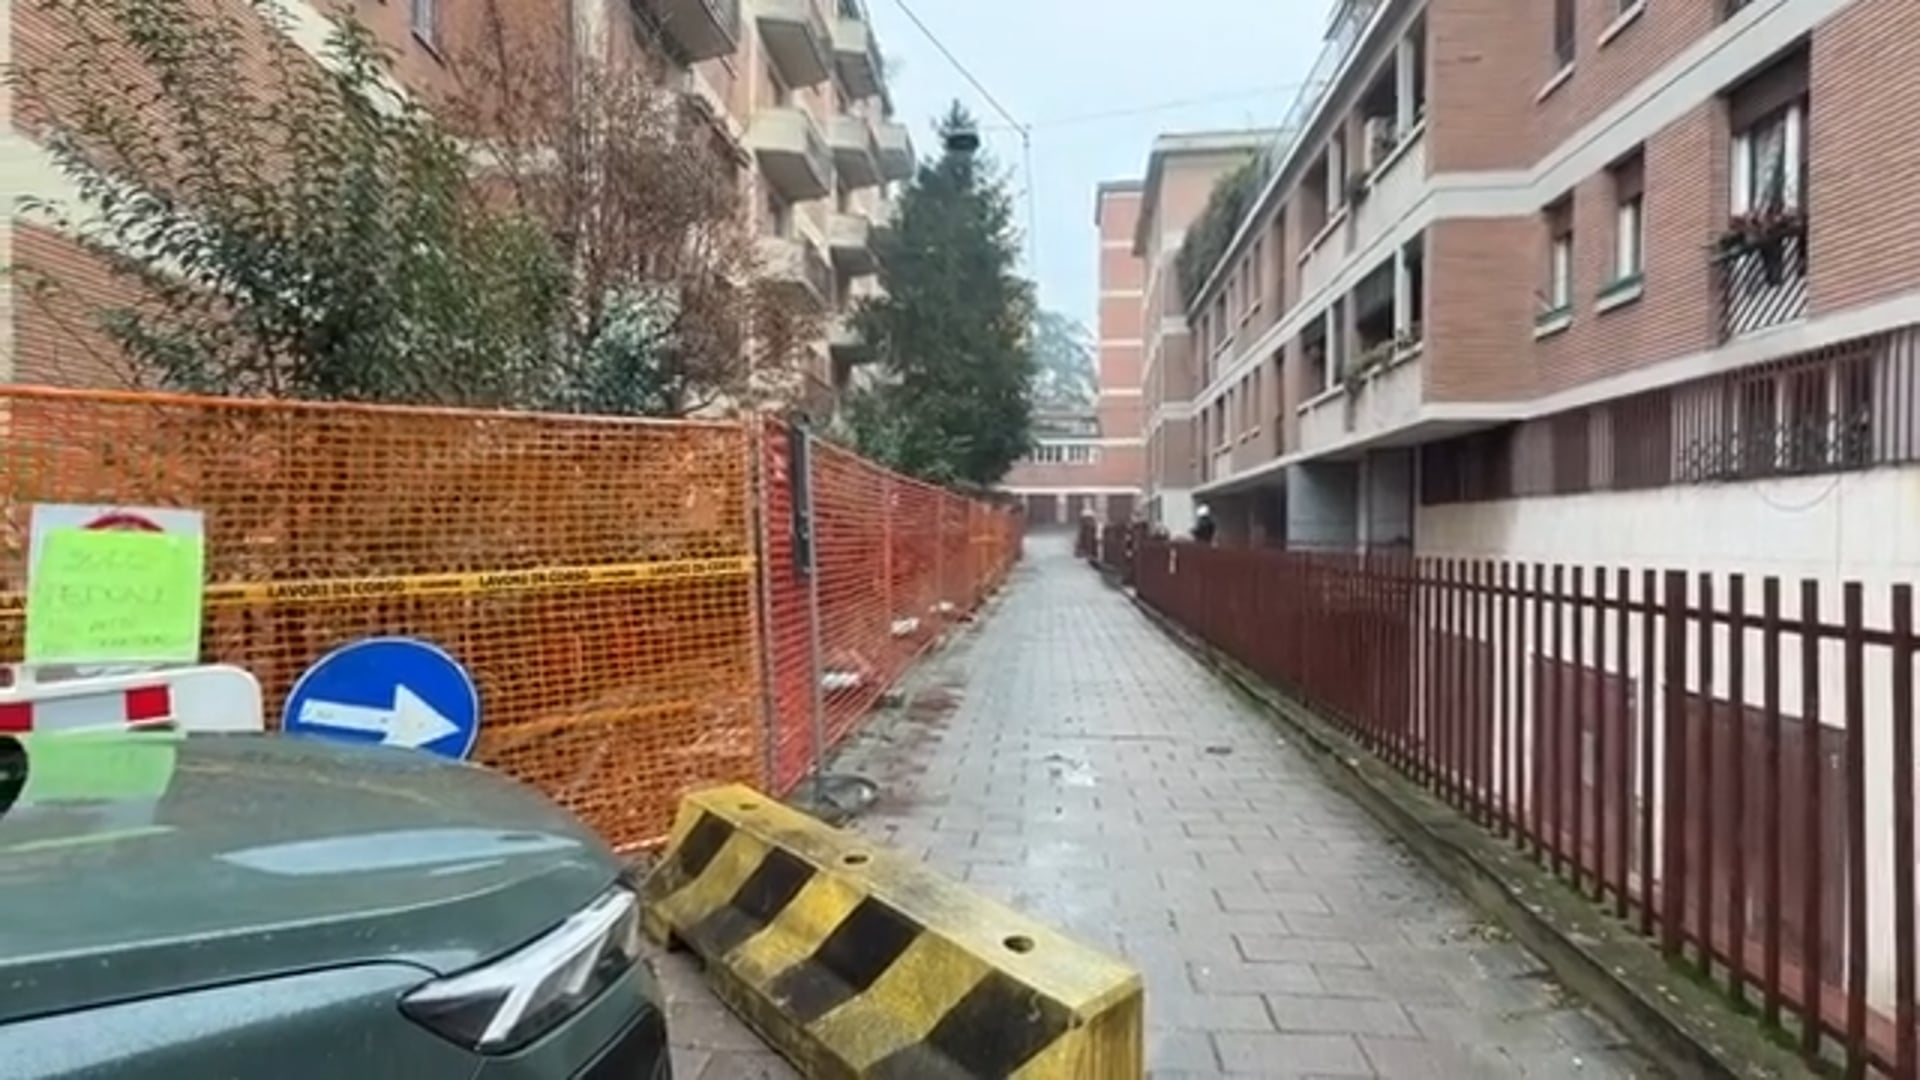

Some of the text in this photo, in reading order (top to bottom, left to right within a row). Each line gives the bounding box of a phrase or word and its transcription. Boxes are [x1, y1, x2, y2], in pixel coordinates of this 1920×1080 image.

[480, 575, 528, 587] LAVORI
[531, 572, 545, 582] IN
[550, 569, 591, 583] CORSO
[267, 583, 328, 598] LAVORI
[333, 582, 350, 595] IN
[354, 580, 405, 595] CORSO
